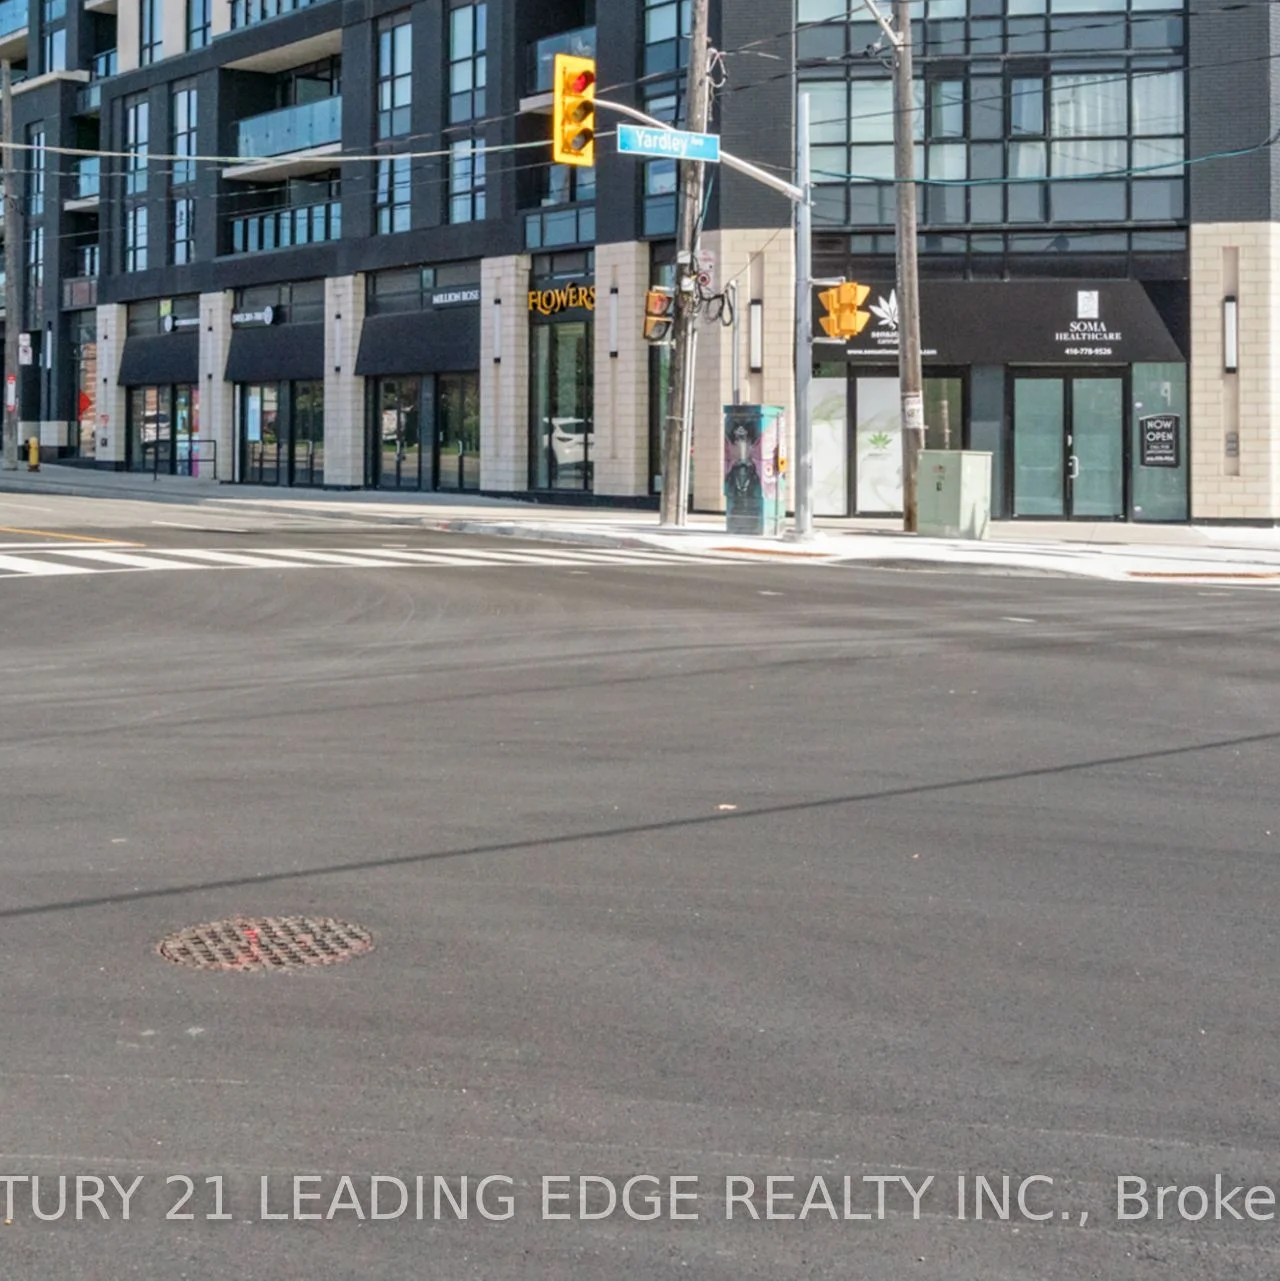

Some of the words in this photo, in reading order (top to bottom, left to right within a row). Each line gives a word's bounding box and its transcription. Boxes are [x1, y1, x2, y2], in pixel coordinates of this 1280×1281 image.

[635, 130, 687, 157] Yardley
[432, 292, 461, 305] MILLION
[462, 290, 480, 301] ROSE
[528, 282, 596, 316] FLOWERS
[1069, 321, 1107, 332] SOMA
[1055, 332, 1122, 341] HEALTHCARE
[1147, 420, 1173, 430] NOW
[1146, 431, 1174, 442] OPEN
